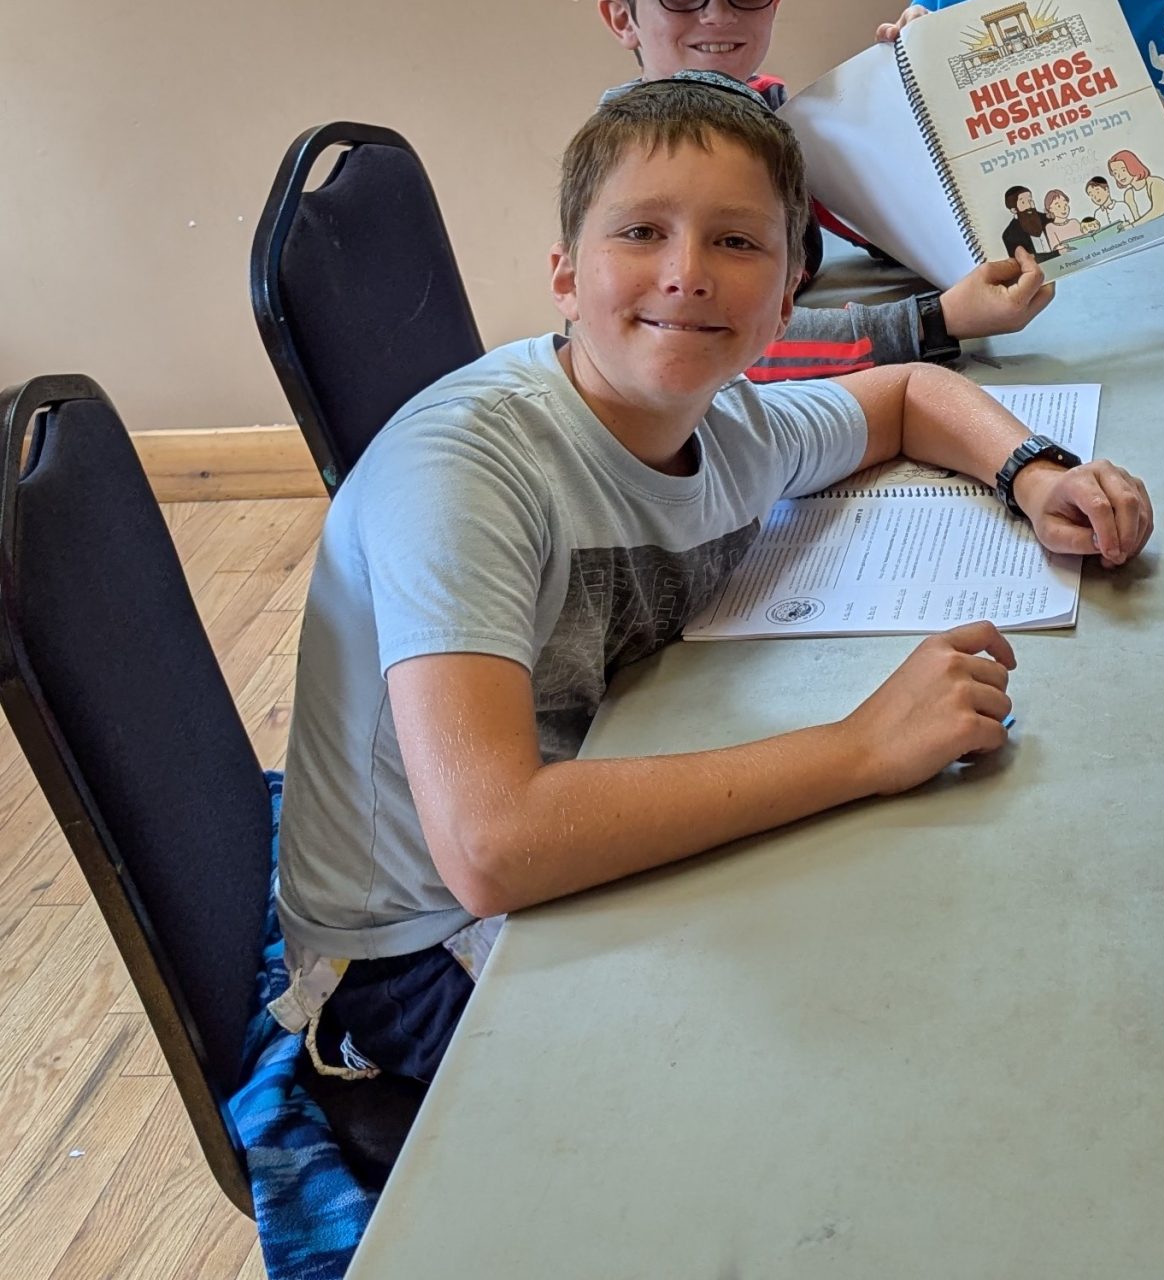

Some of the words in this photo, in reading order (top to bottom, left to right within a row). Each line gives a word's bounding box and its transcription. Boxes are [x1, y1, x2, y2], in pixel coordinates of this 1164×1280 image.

[969, 51, 1094, 112] HILCHOS
[965, 67, 1118, 140] MOSHIACH
[1006, 123, 1044, 145] FOR
[1046, 104, 1092, 131] KIDS
[1031, 128, 1079, 156] הלכות
[1070, 146, 1086, 156] פרק
[980, 145, 1029, 174] מלכים
[1064, 257, 1084, 268] Project
[1101, 240, 1127, 254] Moshiach
[1127, 234, 1145, 244] Office
